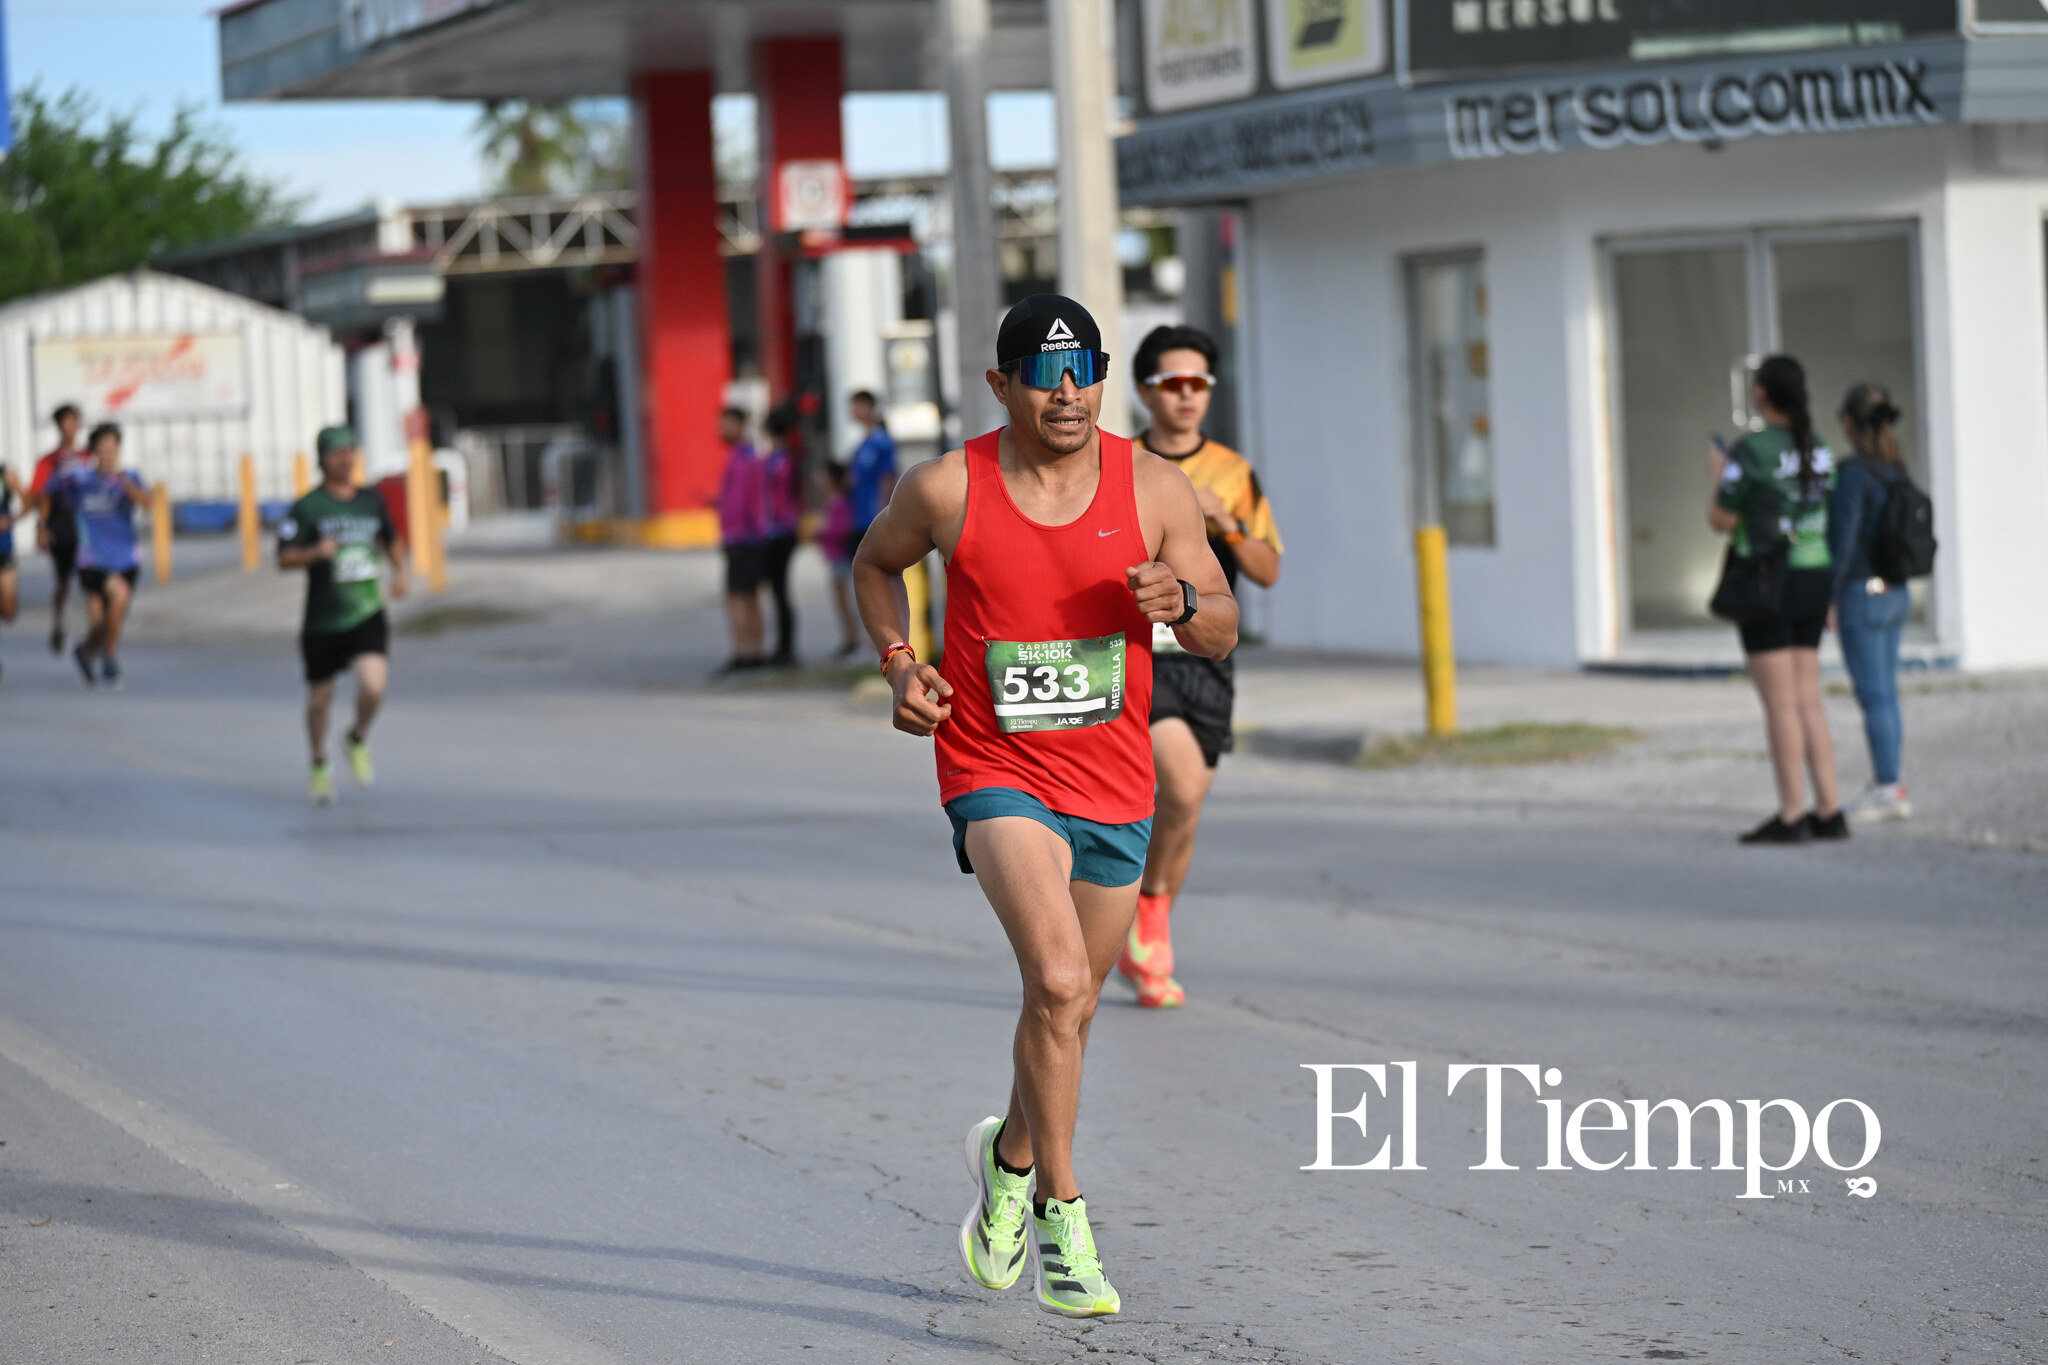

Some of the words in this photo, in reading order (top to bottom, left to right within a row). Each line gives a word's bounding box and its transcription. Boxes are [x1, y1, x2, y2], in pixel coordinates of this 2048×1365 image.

[1040, 340, 1081, 352] Reebok
[1017, 642, 1072, 650] CARRERA
[1109, 638, 1123, 648] 533
[1003, 664, 1090, 702] 533
[1111, 652, 1121, 710] MEDALLA
